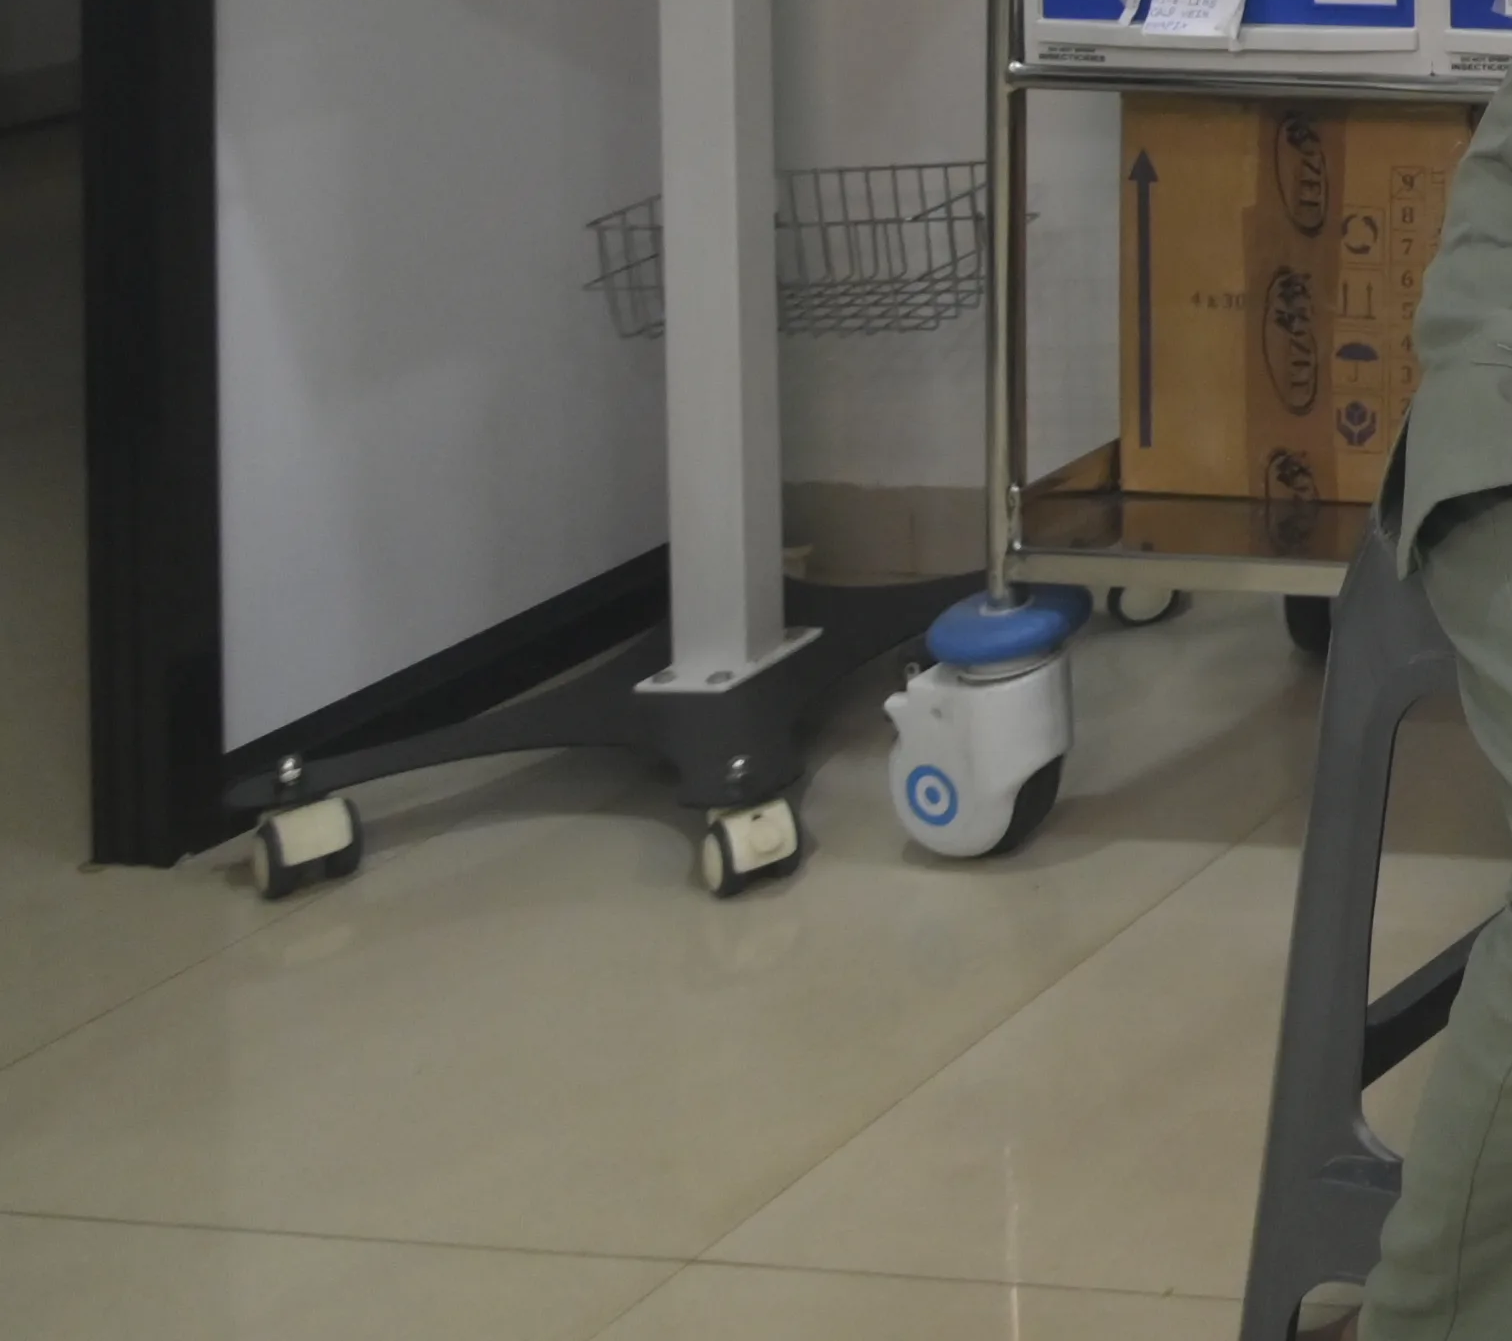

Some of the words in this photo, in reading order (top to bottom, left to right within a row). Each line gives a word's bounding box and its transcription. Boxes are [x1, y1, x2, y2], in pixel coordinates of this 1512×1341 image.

[1403, 207, 1413, 224] 8
[1403, 238, 1412, 255] 7
[1403, 271, 1413, 289] 6
